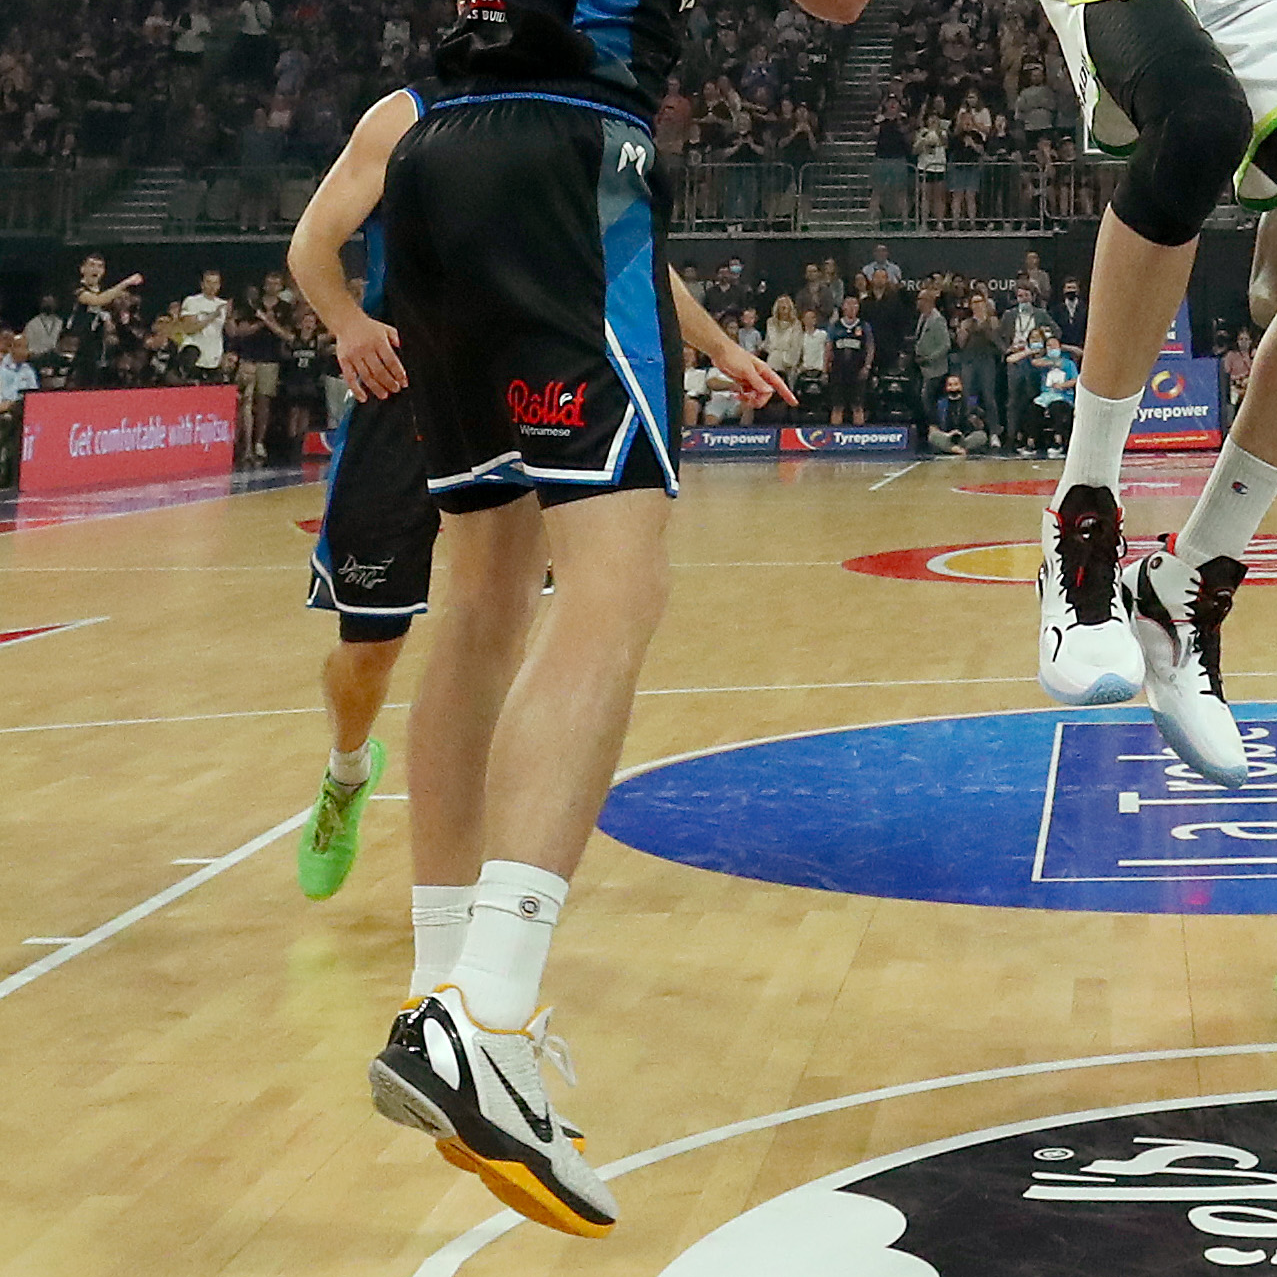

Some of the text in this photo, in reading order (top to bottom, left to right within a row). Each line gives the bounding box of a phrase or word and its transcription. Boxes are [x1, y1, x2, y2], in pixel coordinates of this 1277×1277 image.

[69, 422, 94, 458] Get
[702, 432, 771, 446] Tyrepower
[833, 431, 903, 446] Tyrepower
